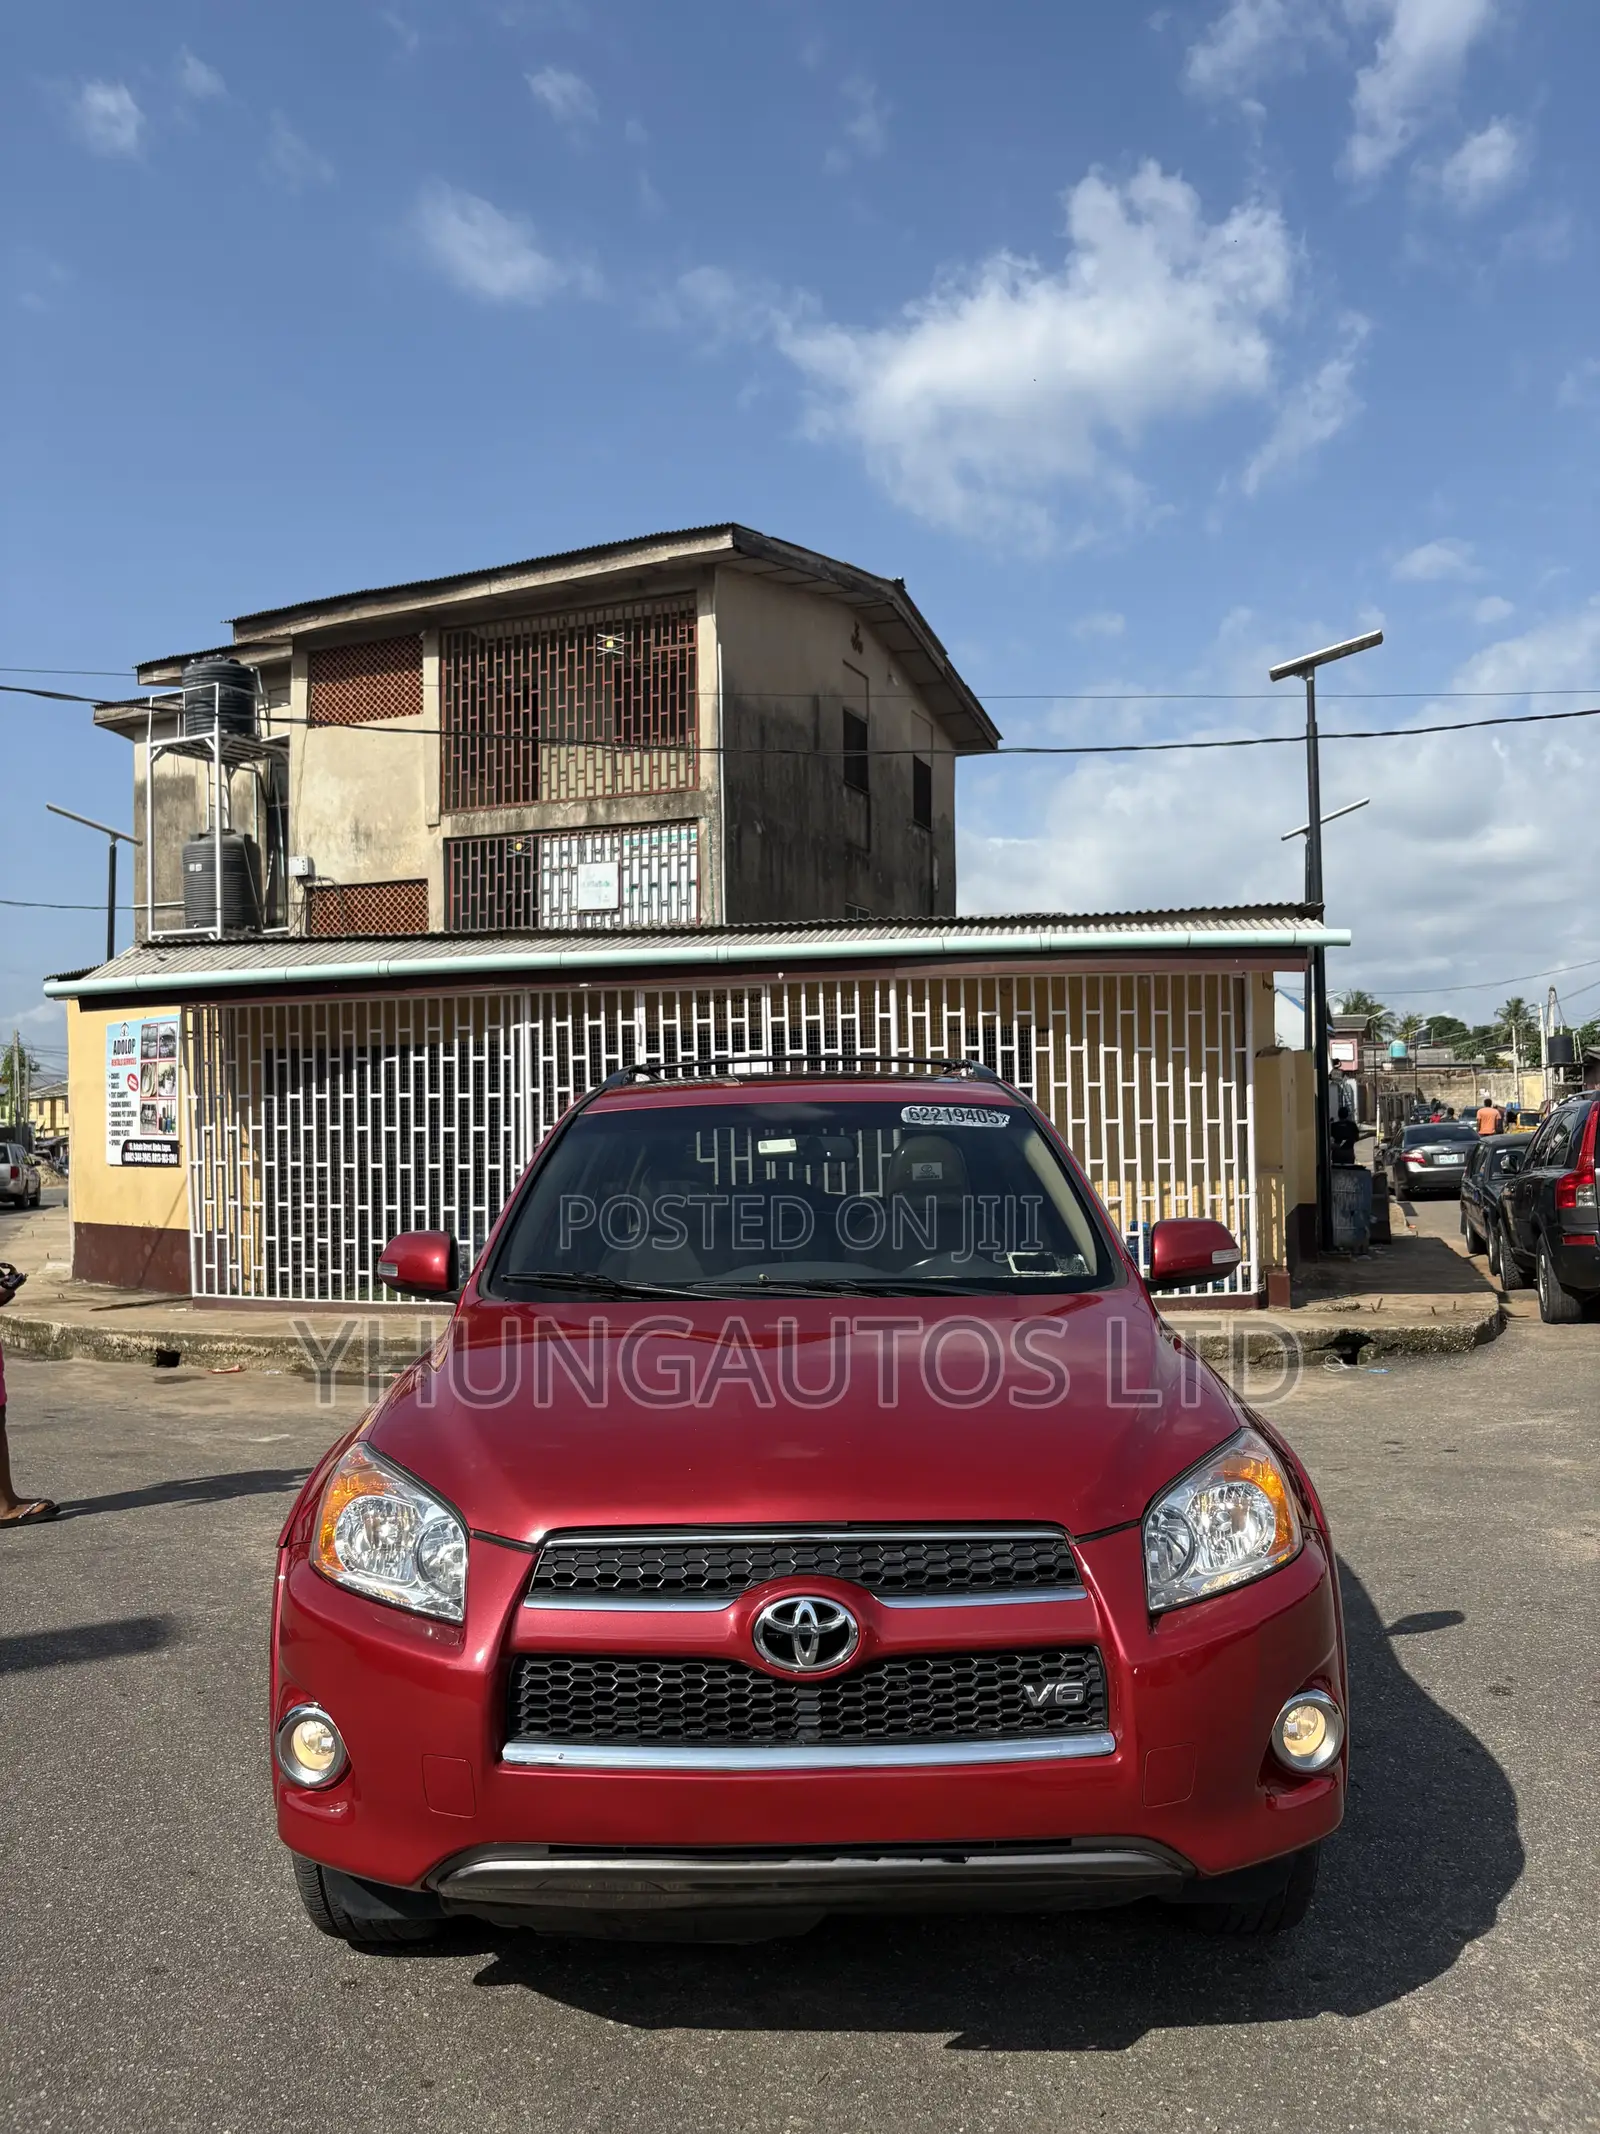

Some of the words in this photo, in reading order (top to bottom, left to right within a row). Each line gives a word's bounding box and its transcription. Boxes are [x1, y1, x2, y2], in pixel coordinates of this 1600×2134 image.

[113, 1038, 136, 1056] ADOLOP
[908, 1107, 998, 1124] 62219405
[1023, 1682, 1085, 1707] V6
